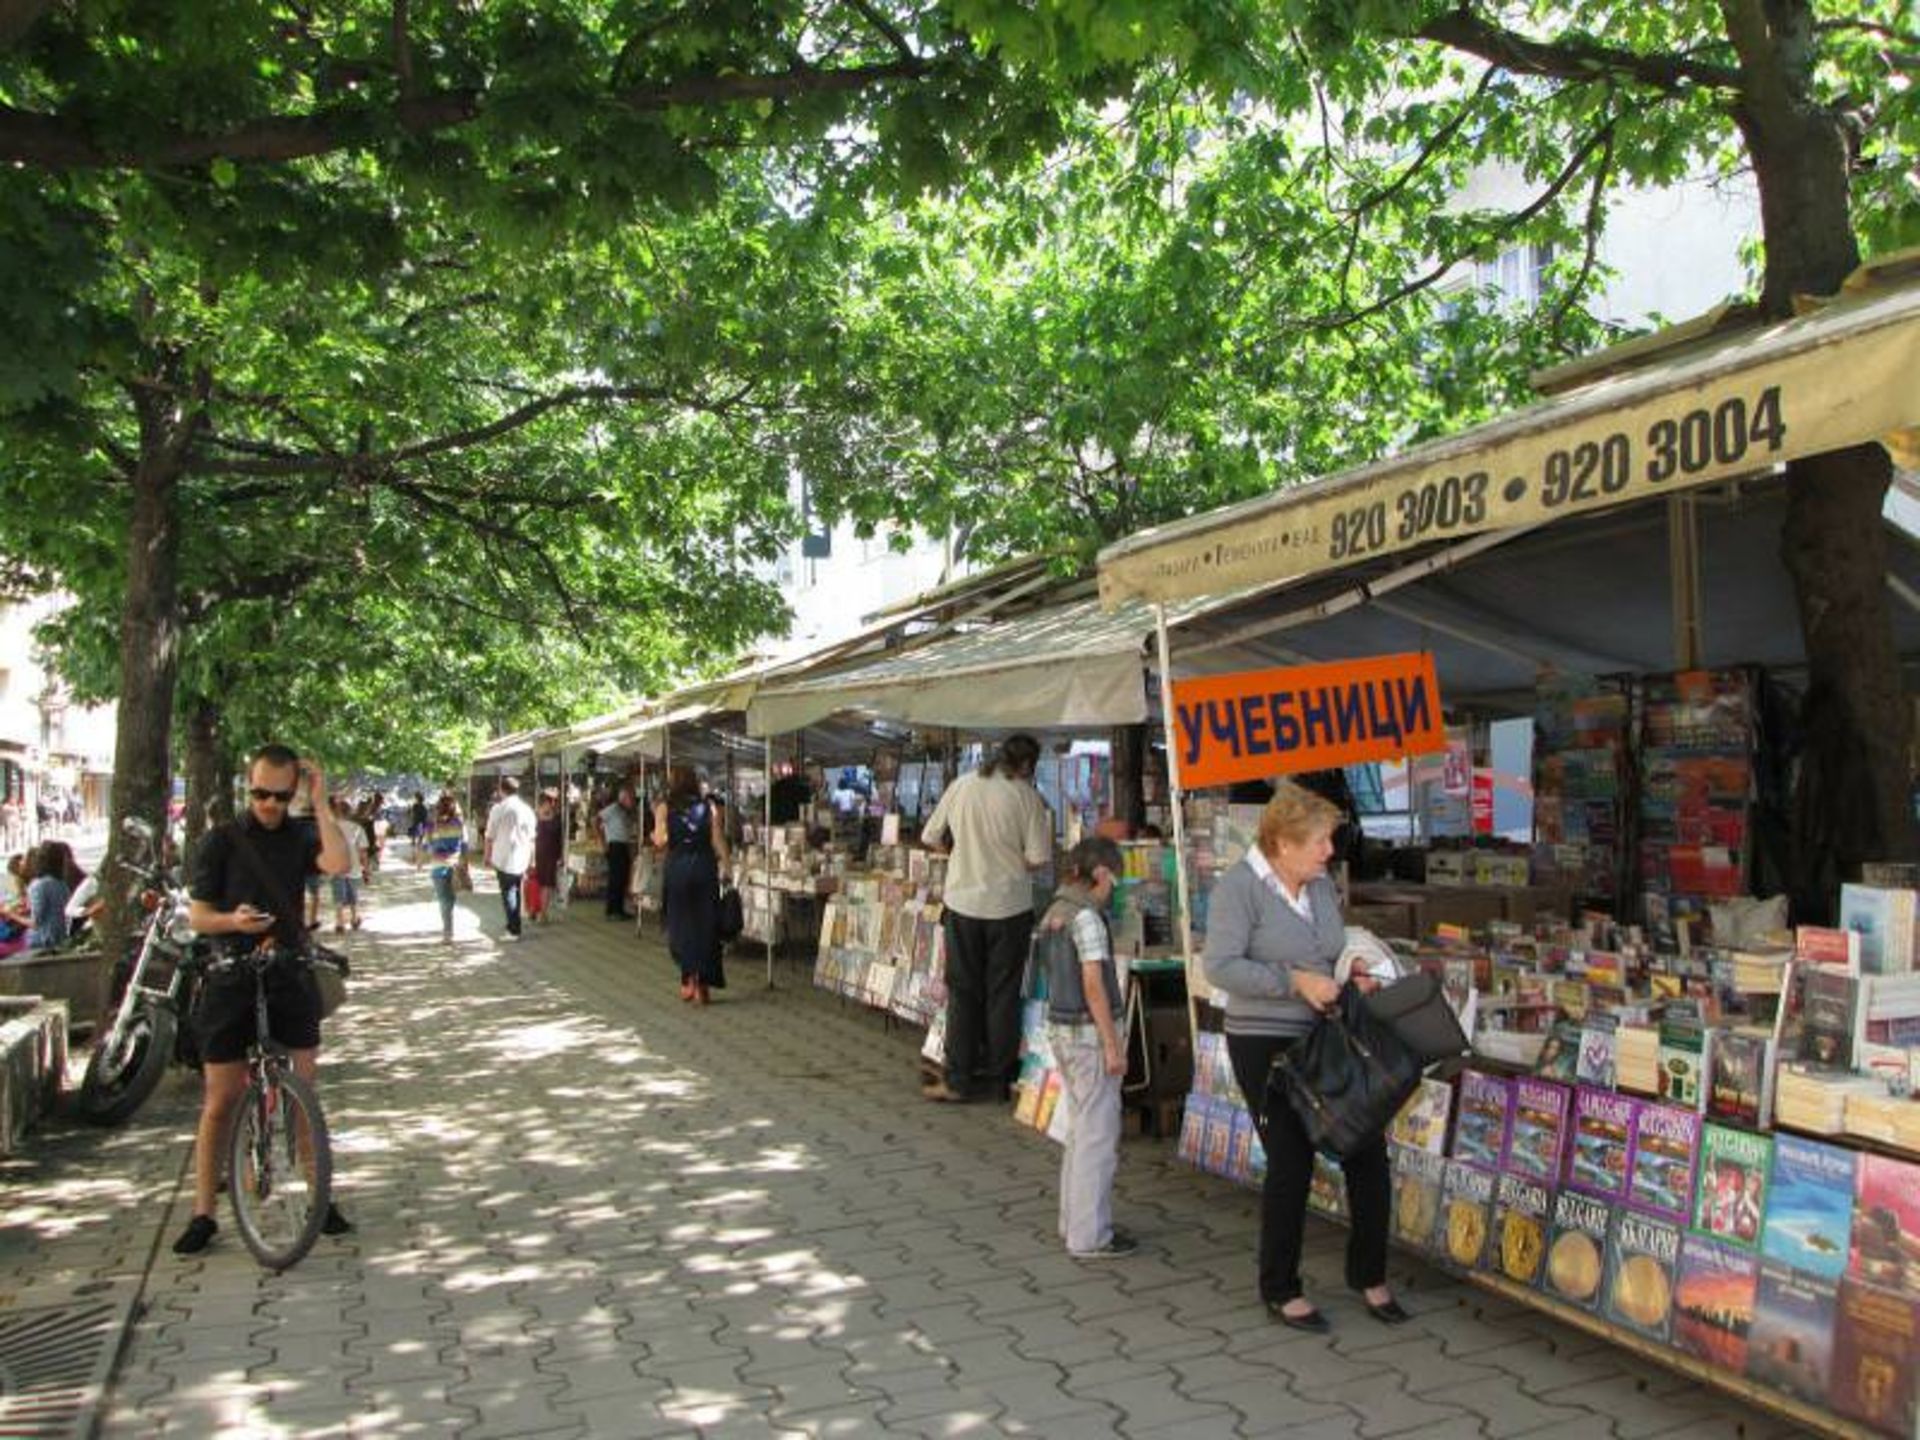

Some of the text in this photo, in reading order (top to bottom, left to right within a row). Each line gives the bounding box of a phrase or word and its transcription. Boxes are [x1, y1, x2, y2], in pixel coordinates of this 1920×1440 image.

[1329, 501, 1385, 560] 920
[1396, 471, 1489, 540] 3003
[1541, 433, 1631, 507] 920
[1646, 386, 1787, 482] 3004
[1177, 676, 1431, 765] УЧЕБНИЦИ
